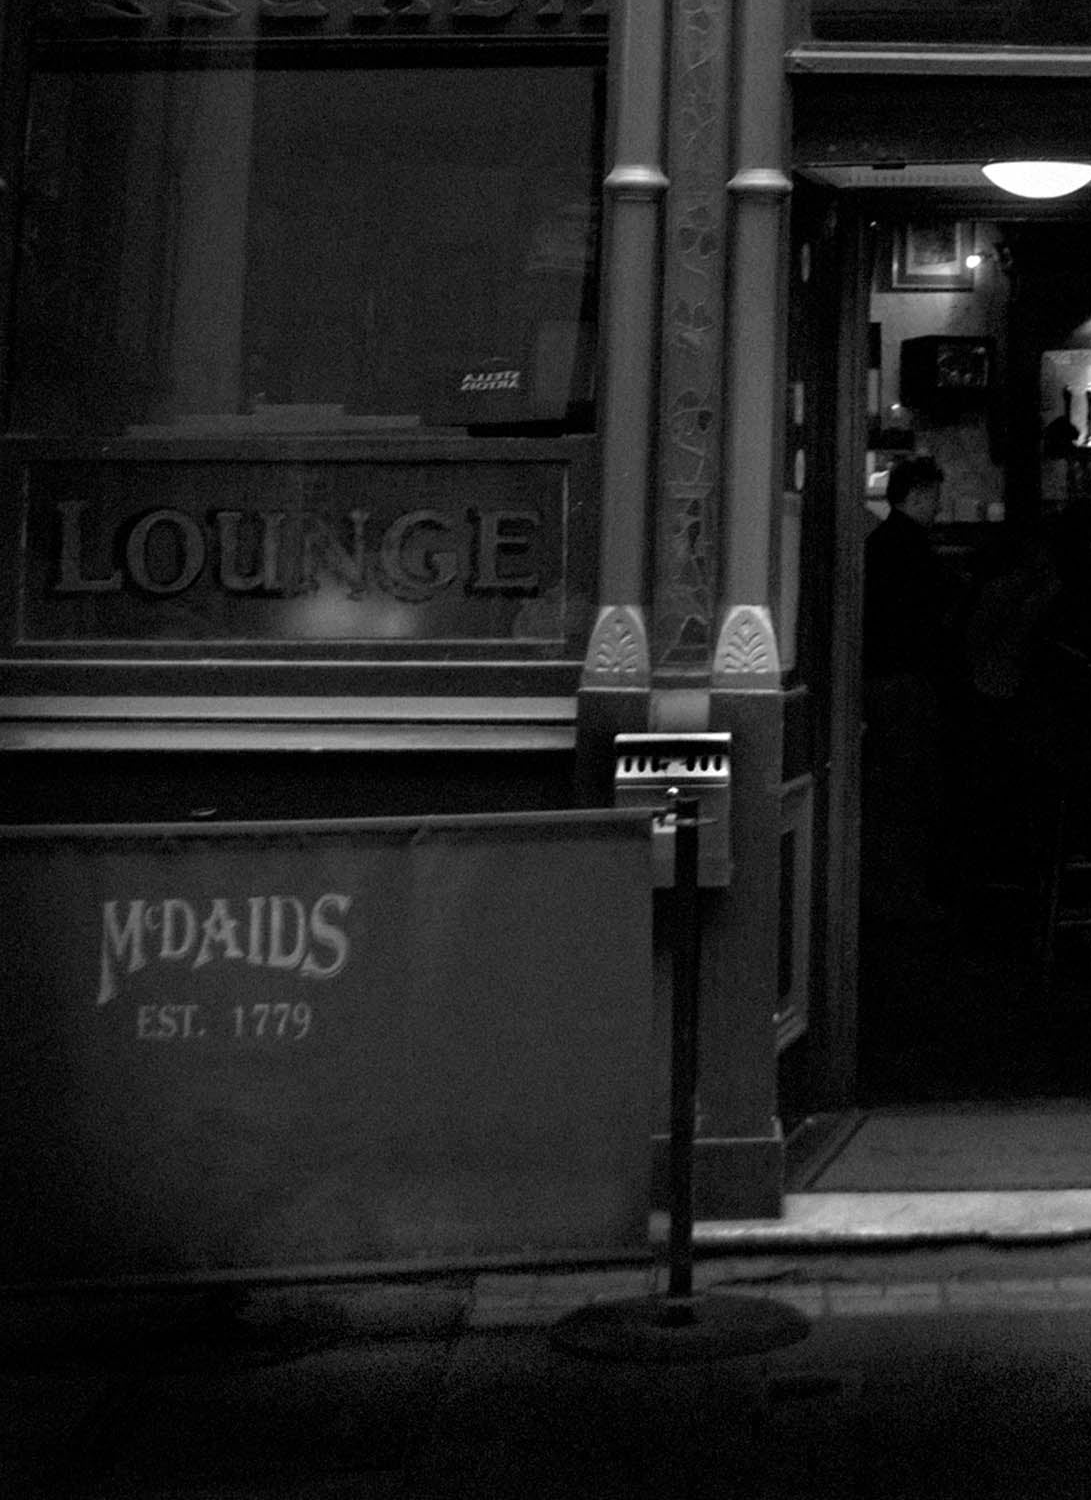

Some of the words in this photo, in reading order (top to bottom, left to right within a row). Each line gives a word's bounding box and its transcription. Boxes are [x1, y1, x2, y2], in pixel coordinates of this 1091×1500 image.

[53, 501, 540, 597] LOUNGE
[137, 1004, 205, 1039] EST.
[232, 1003, 312, 1039] 1779
